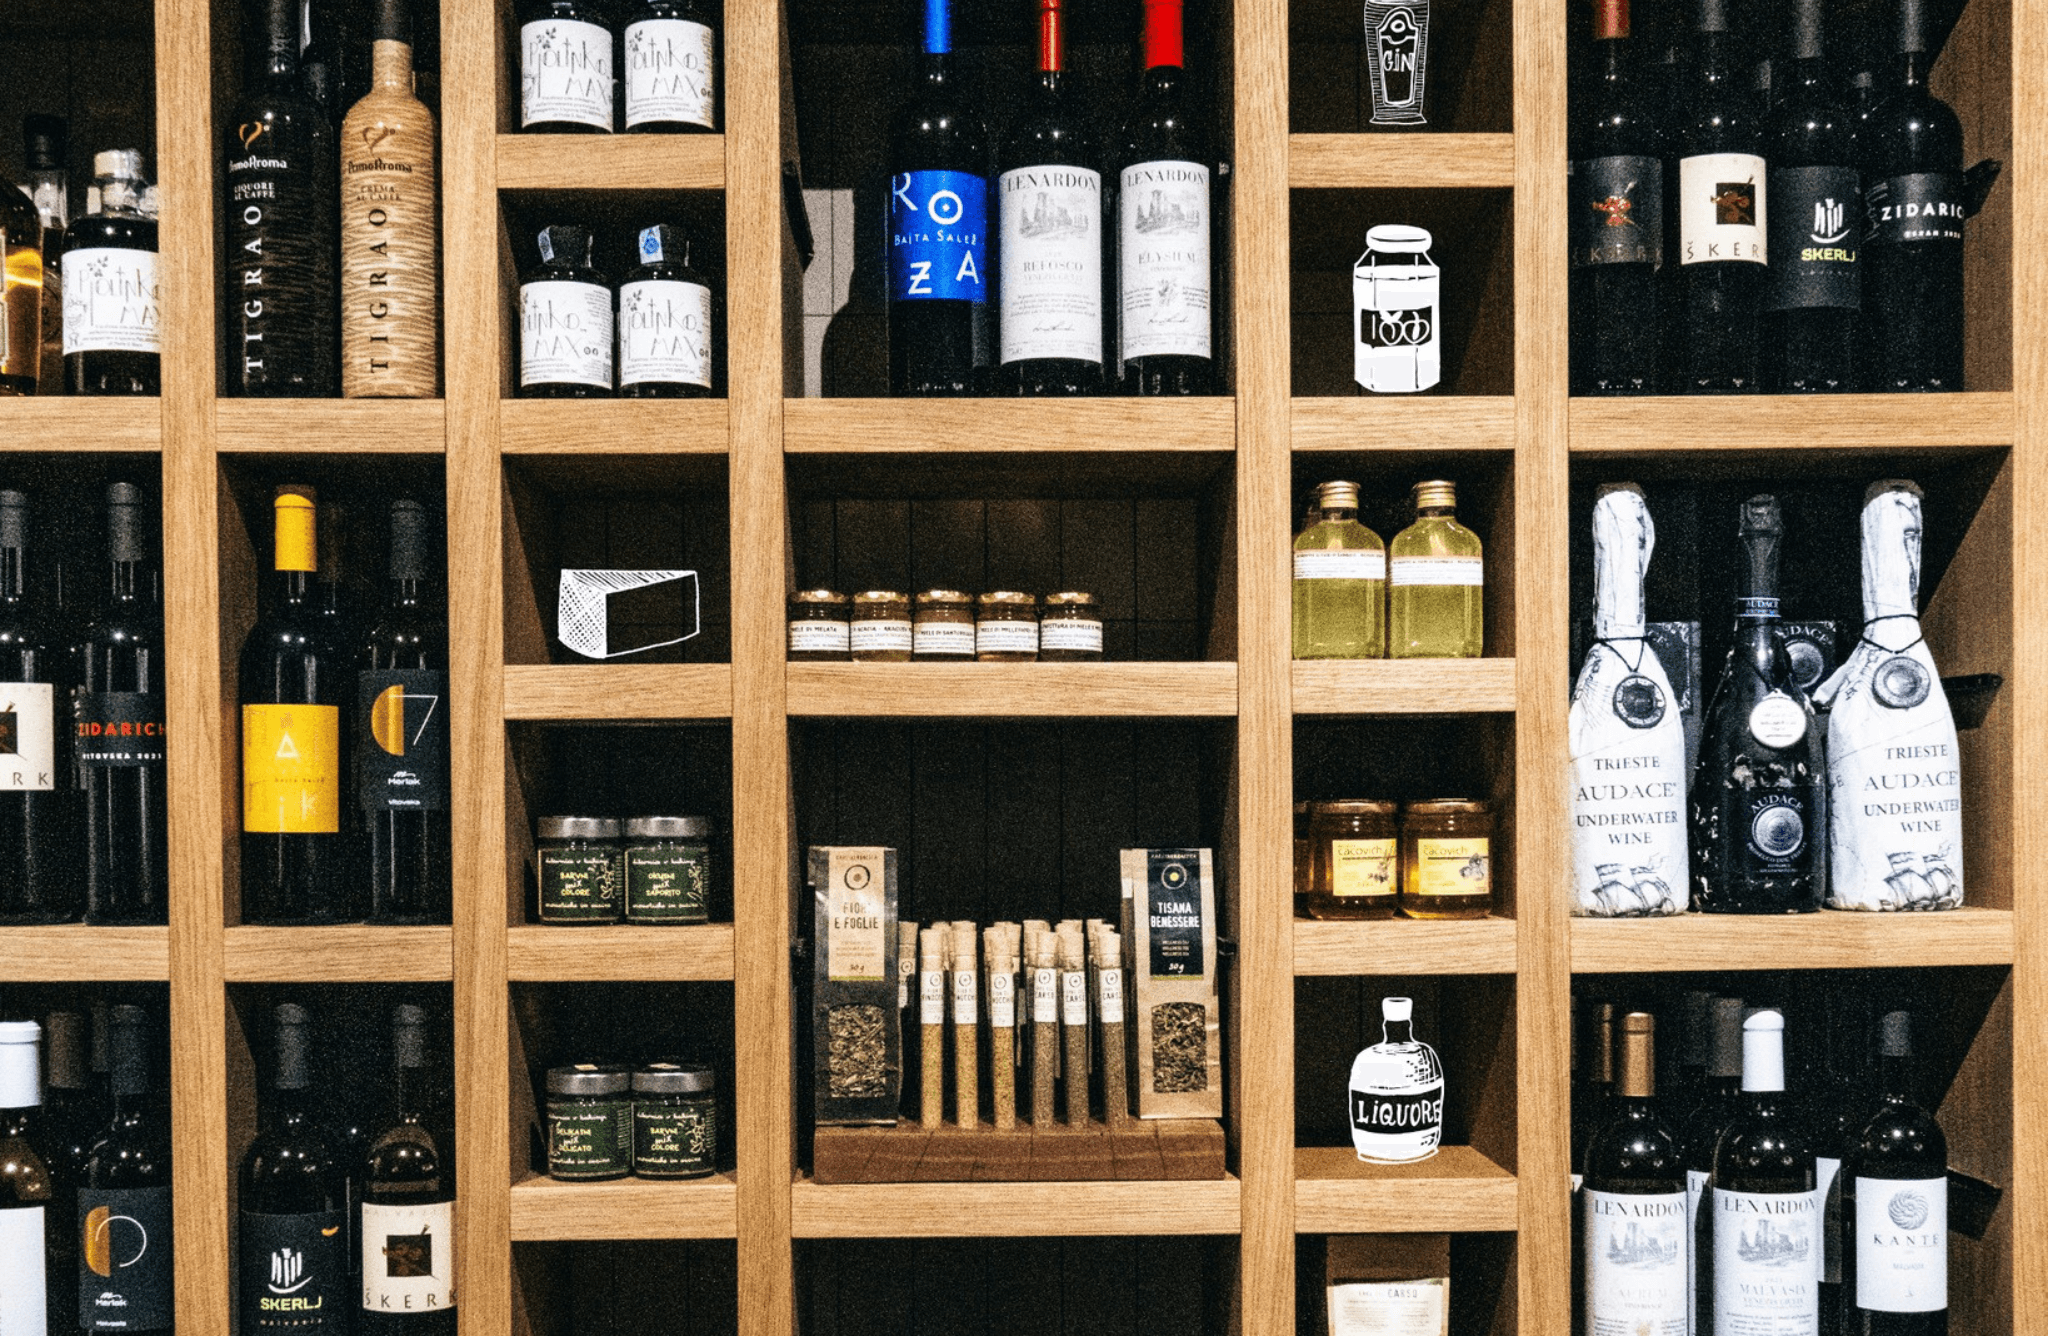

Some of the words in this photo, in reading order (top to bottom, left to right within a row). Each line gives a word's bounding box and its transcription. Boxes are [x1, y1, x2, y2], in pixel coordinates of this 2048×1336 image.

[243, 205, 264, 374] TIGRAO
[368, 208, 389, 374] TIGRAO
[1885, 744, 1948, 760] TRIESTE
[1593, 755, 1660, 771] TRIESTE
[1576, 810, 1678, 827] UNDERWATER
[1901, 820, 1941, 832] WINE
[1608, 832, 1653, 845] WINE
[1158, 902, 1192, 914] TISANA
[843, 917, 879, 929] FOGLIE
[1150, 915, 1200, 928] BENESSERE
[1873, 1233, 1939, 1246] KANTE
